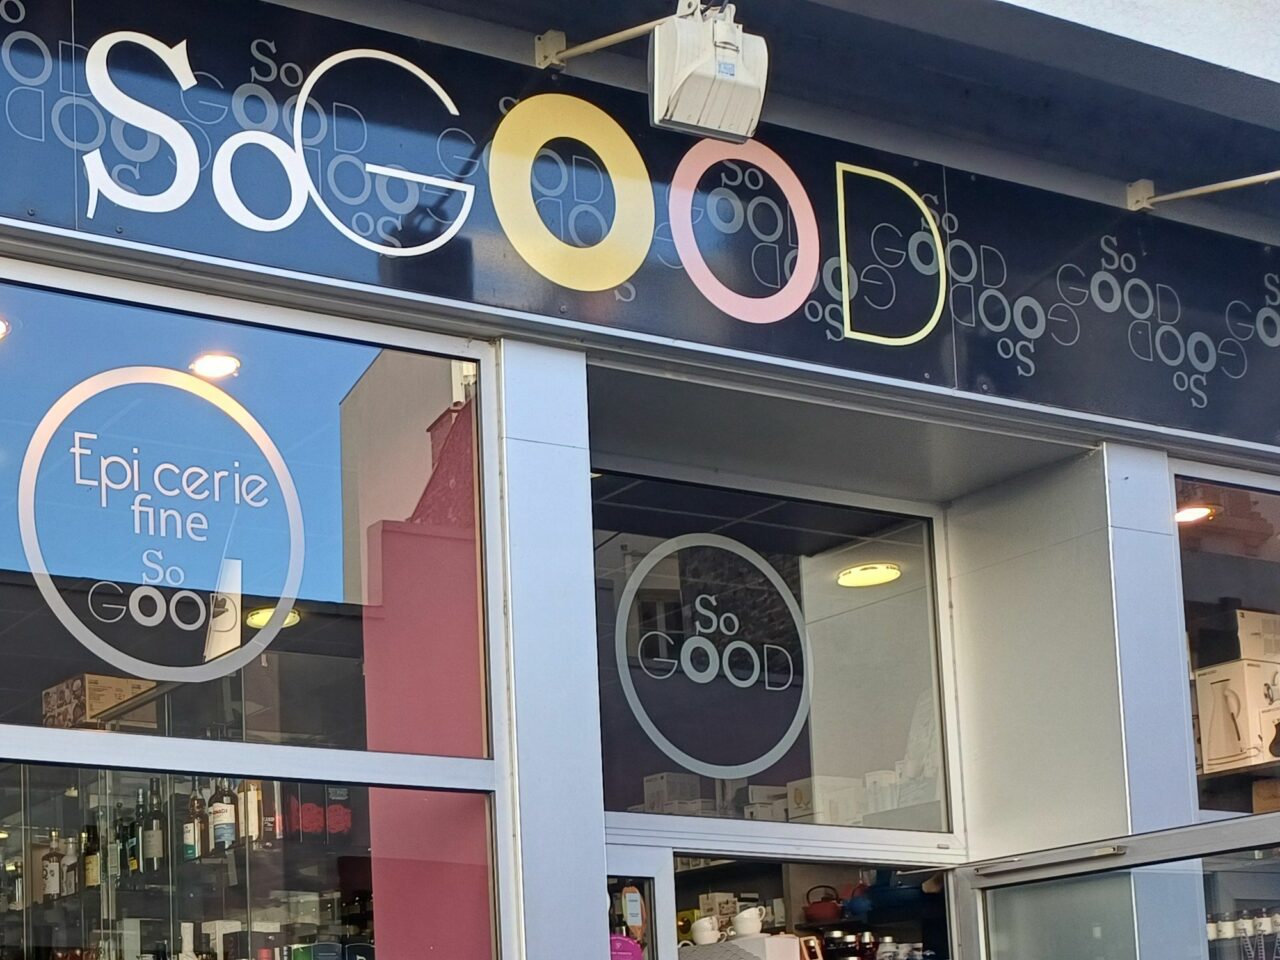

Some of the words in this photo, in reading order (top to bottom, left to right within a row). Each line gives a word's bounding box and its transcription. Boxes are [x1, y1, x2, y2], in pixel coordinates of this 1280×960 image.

[131, 494, 210, 541] fine
[142, 549, 186, 588] So
[88, 580, 239, 633] GOOD
[694, 594, 740, 636] So
[637, 631, 794, 691] GOOD
